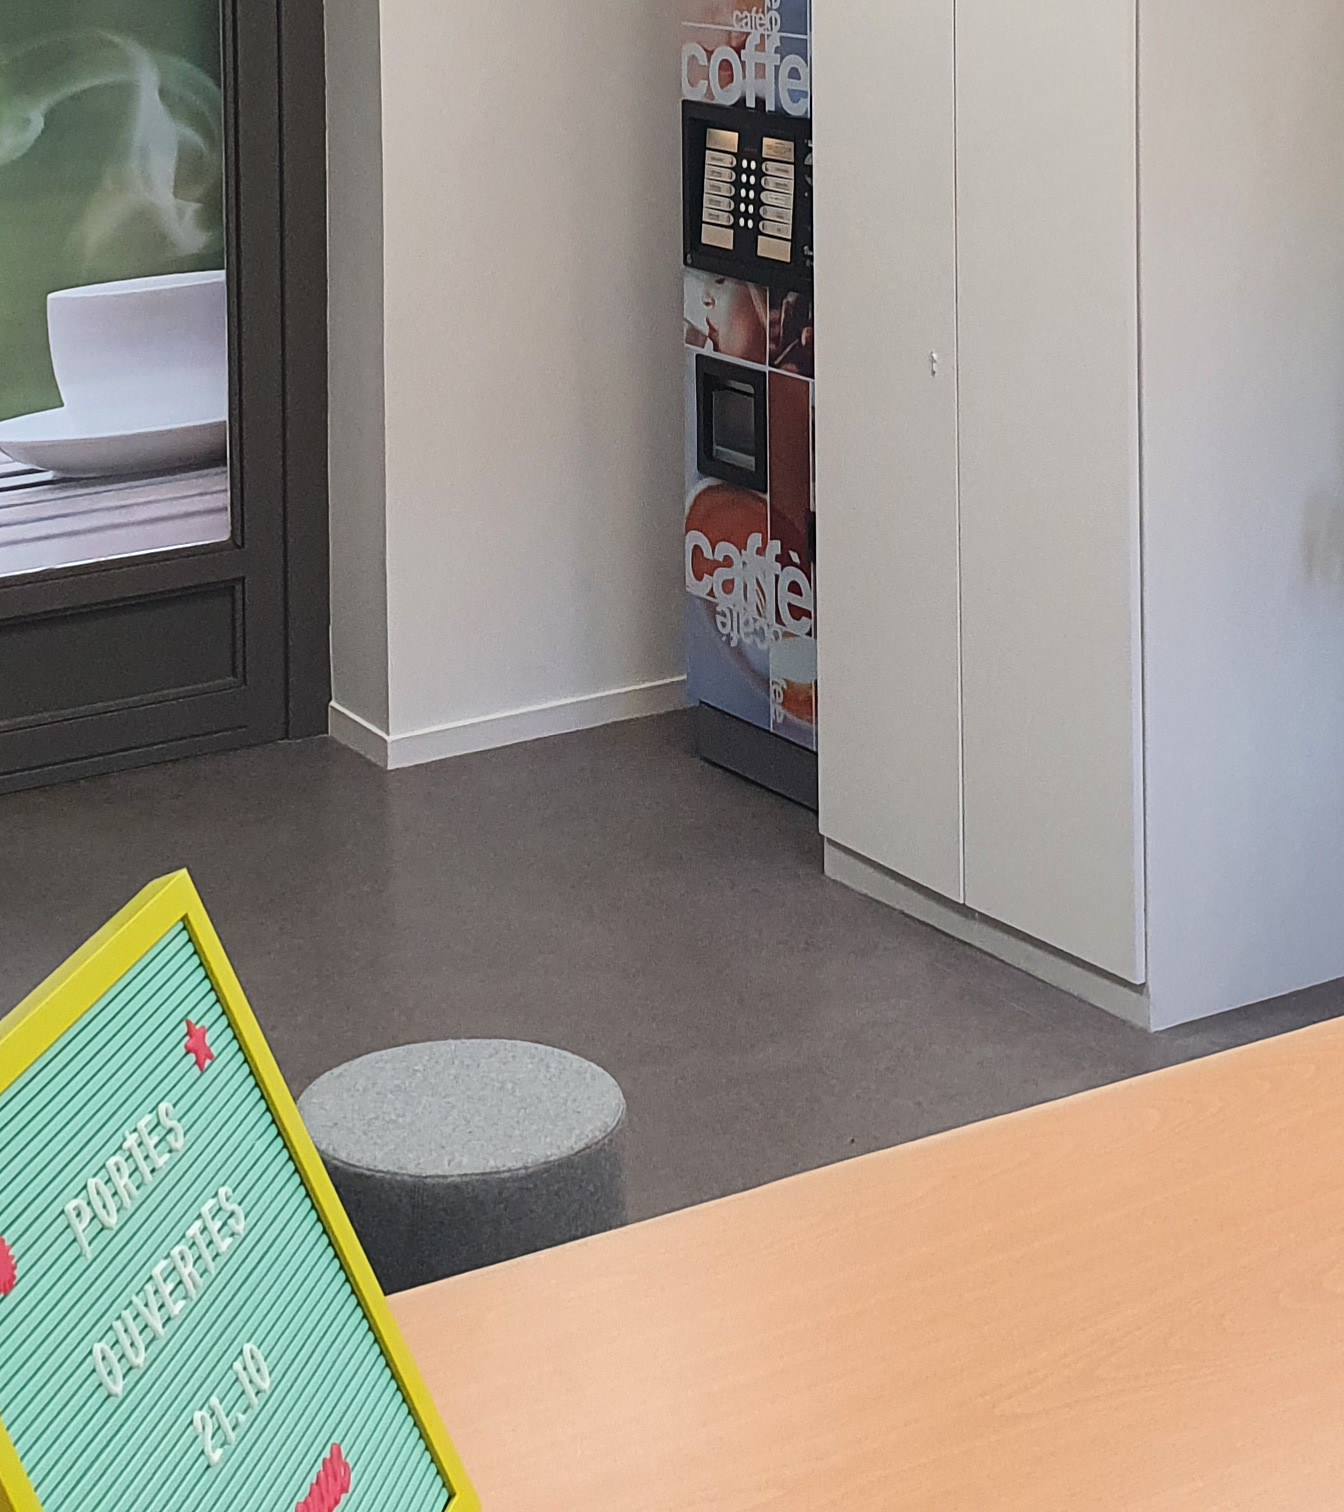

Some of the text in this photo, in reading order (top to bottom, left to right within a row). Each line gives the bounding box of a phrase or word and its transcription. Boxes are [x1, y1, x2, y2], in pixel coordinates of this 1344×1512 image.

[685, 530, 812, 636] caffè
[64, 1100, 186, 1261] PORTES
[92, 1185, 246, 1398] OUVERTES
[192, 1341, 271, 1467] 21.10
